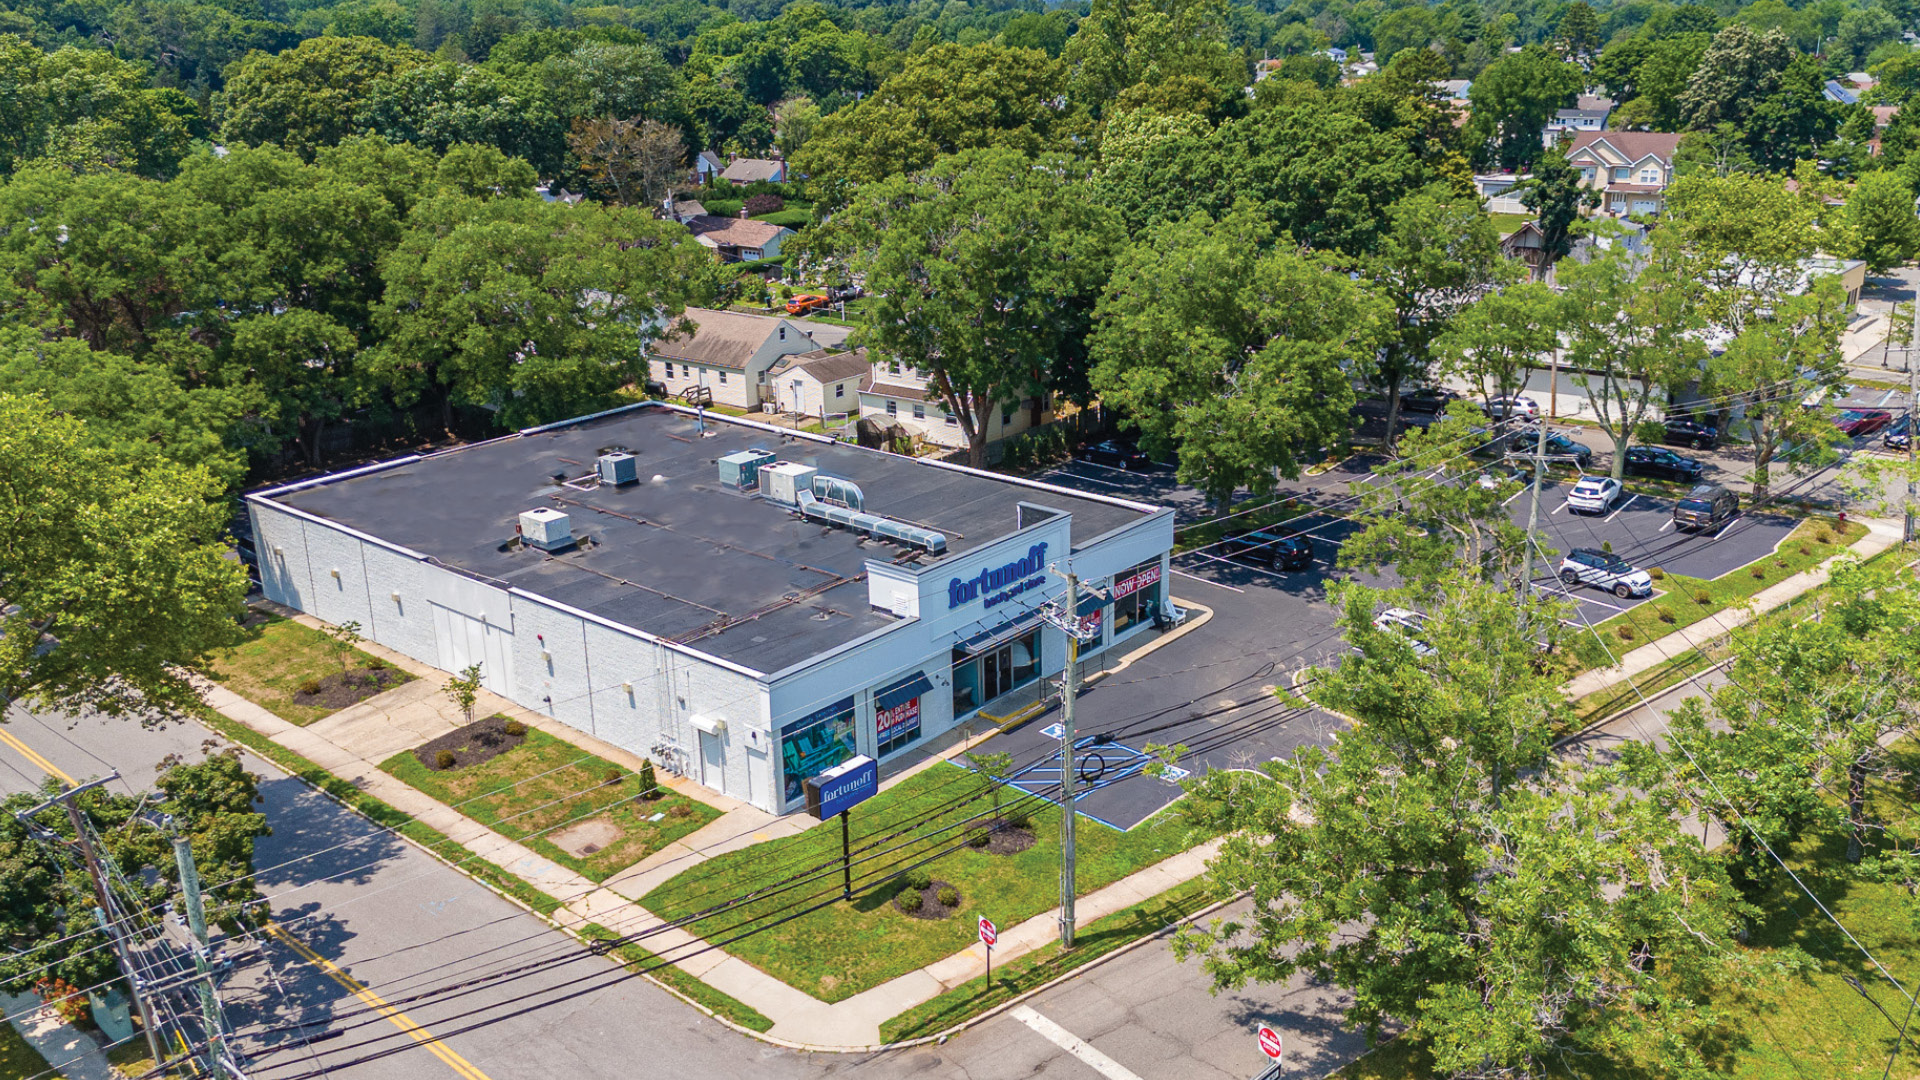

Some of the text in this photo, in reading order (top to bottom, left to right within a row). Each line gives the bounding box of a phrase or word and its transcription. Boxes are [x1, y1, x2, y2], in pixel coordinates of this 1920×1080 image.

[948, 541, 1048, 609] fortunoff
[984, 575, 1046, 608] backyard store
[1114, 579, 1135, 598] NOW
[877, 711, 890, 731] 20
[823, 769, 873, 802] fortunoff
[1263, 1042, 1277, 1055] ENTER
[1269, 1035, 1278, 1043] NOT
